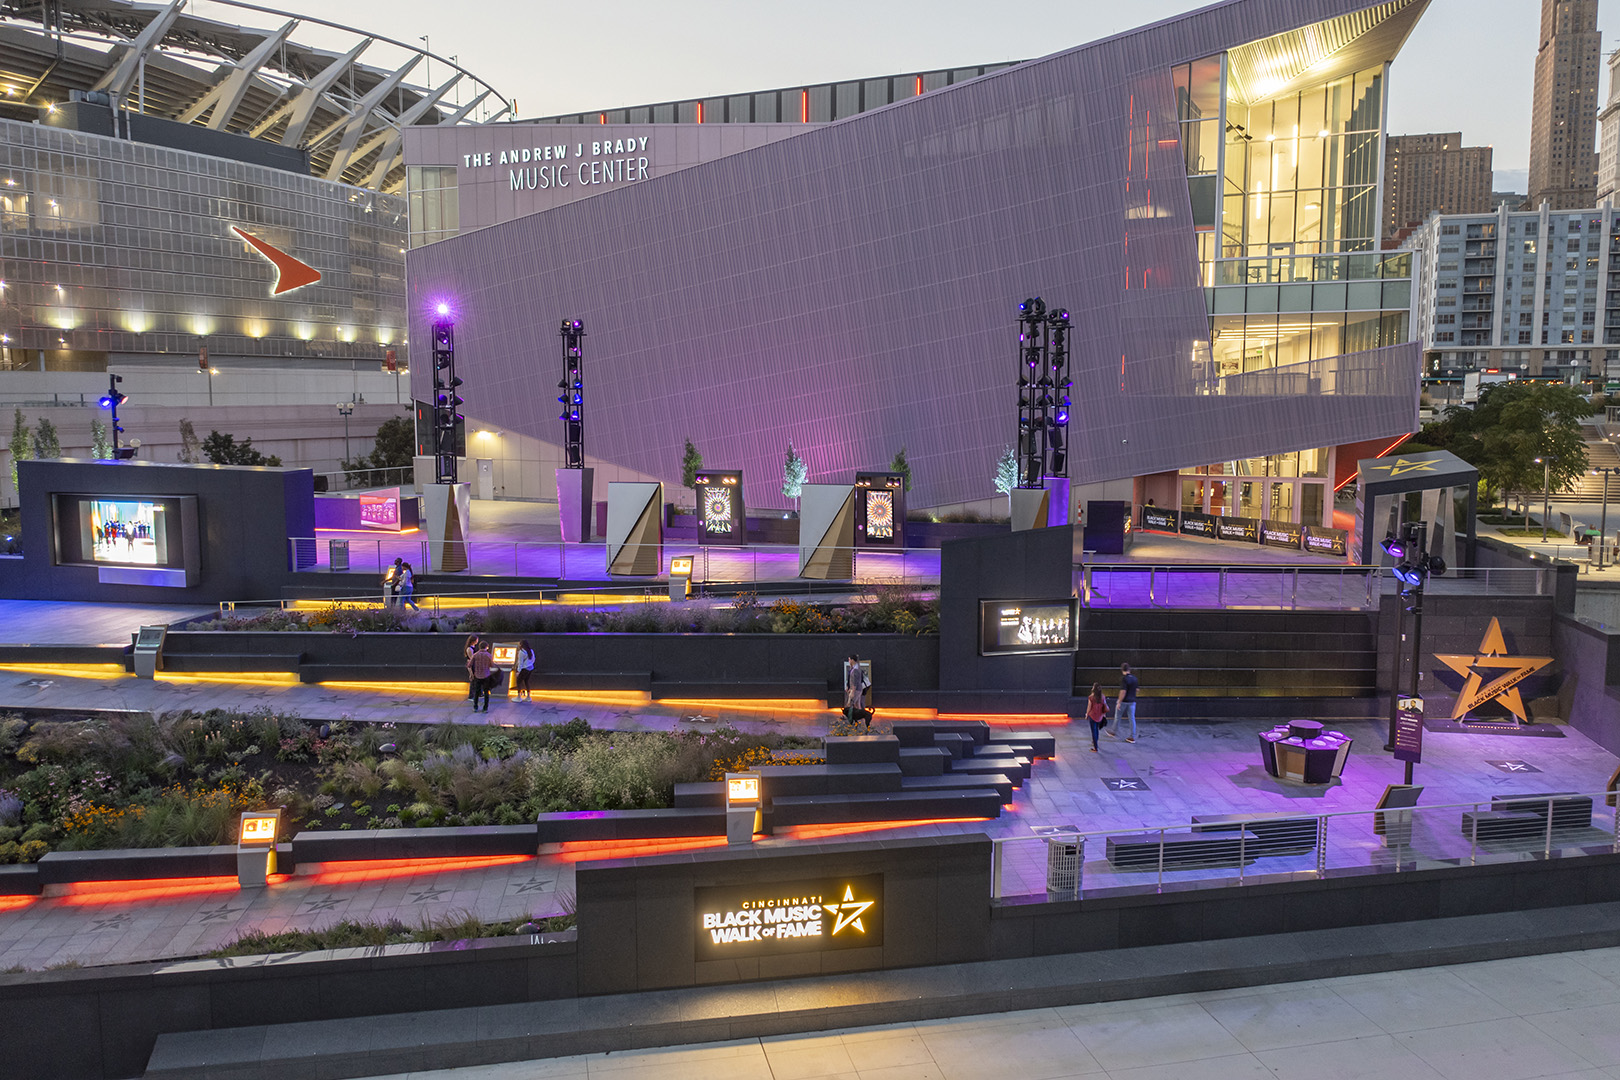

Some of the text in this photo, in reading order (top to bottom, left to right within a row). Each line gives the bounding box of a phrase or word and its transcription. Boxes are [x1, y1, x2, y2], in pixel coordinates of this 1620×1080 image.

[464, 137, 649, 168] THE ANDREW J BRADY
[509, 157, 650, 191] MUSIC CENTER
[1467, 697, 1486, 709] BLACK
[1485, 686, 1503, 698] MUSIC
[1502, 677, 1518, 688] WALK
[742, 895, 823, 909] CINCINNATI
[703, 905, 822, 929] BLACK MUSIC
[711, 920, 822, 944] WALK OF FAME
